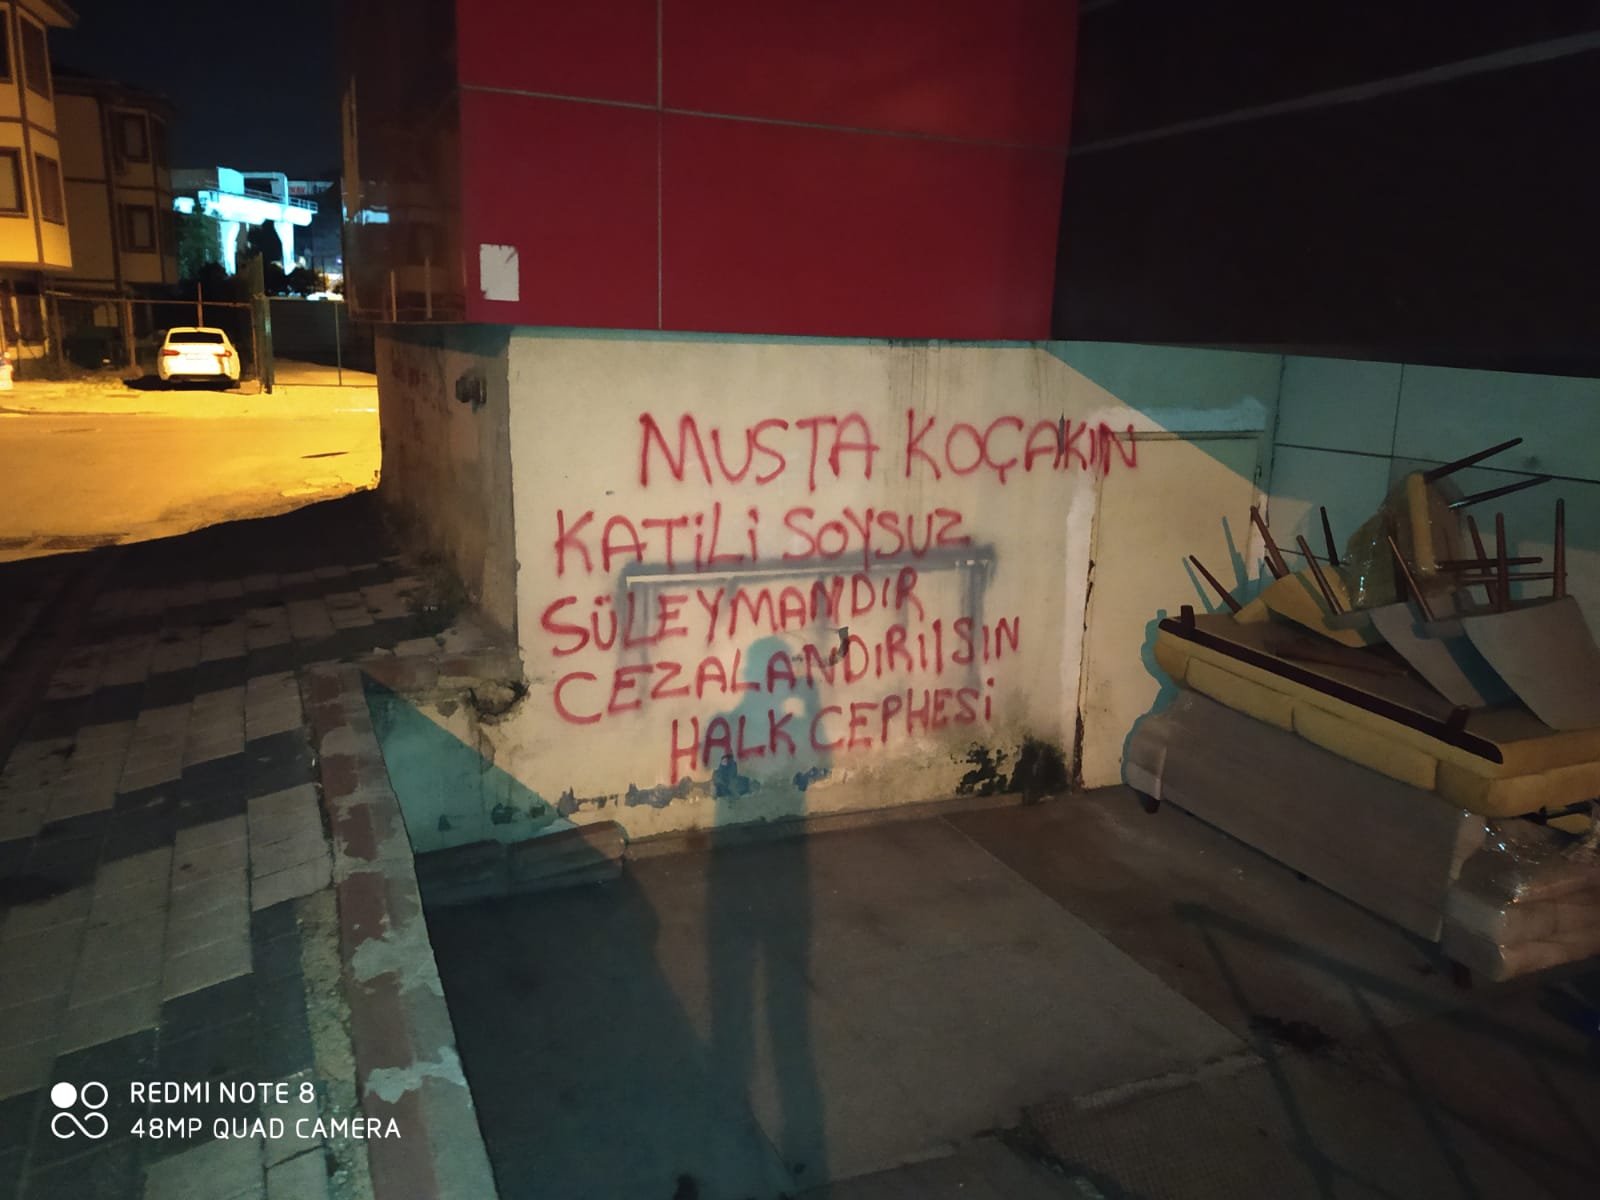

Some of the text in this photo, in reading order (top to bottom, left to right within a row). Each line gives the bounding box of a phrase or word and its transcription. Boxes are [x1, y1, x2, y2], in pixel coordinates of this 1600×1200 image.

[639, 412, 880, 491] MUSTA
[782, 506, 972, 572] SOYSUZ
[670, 709, 796, 785] HALK
